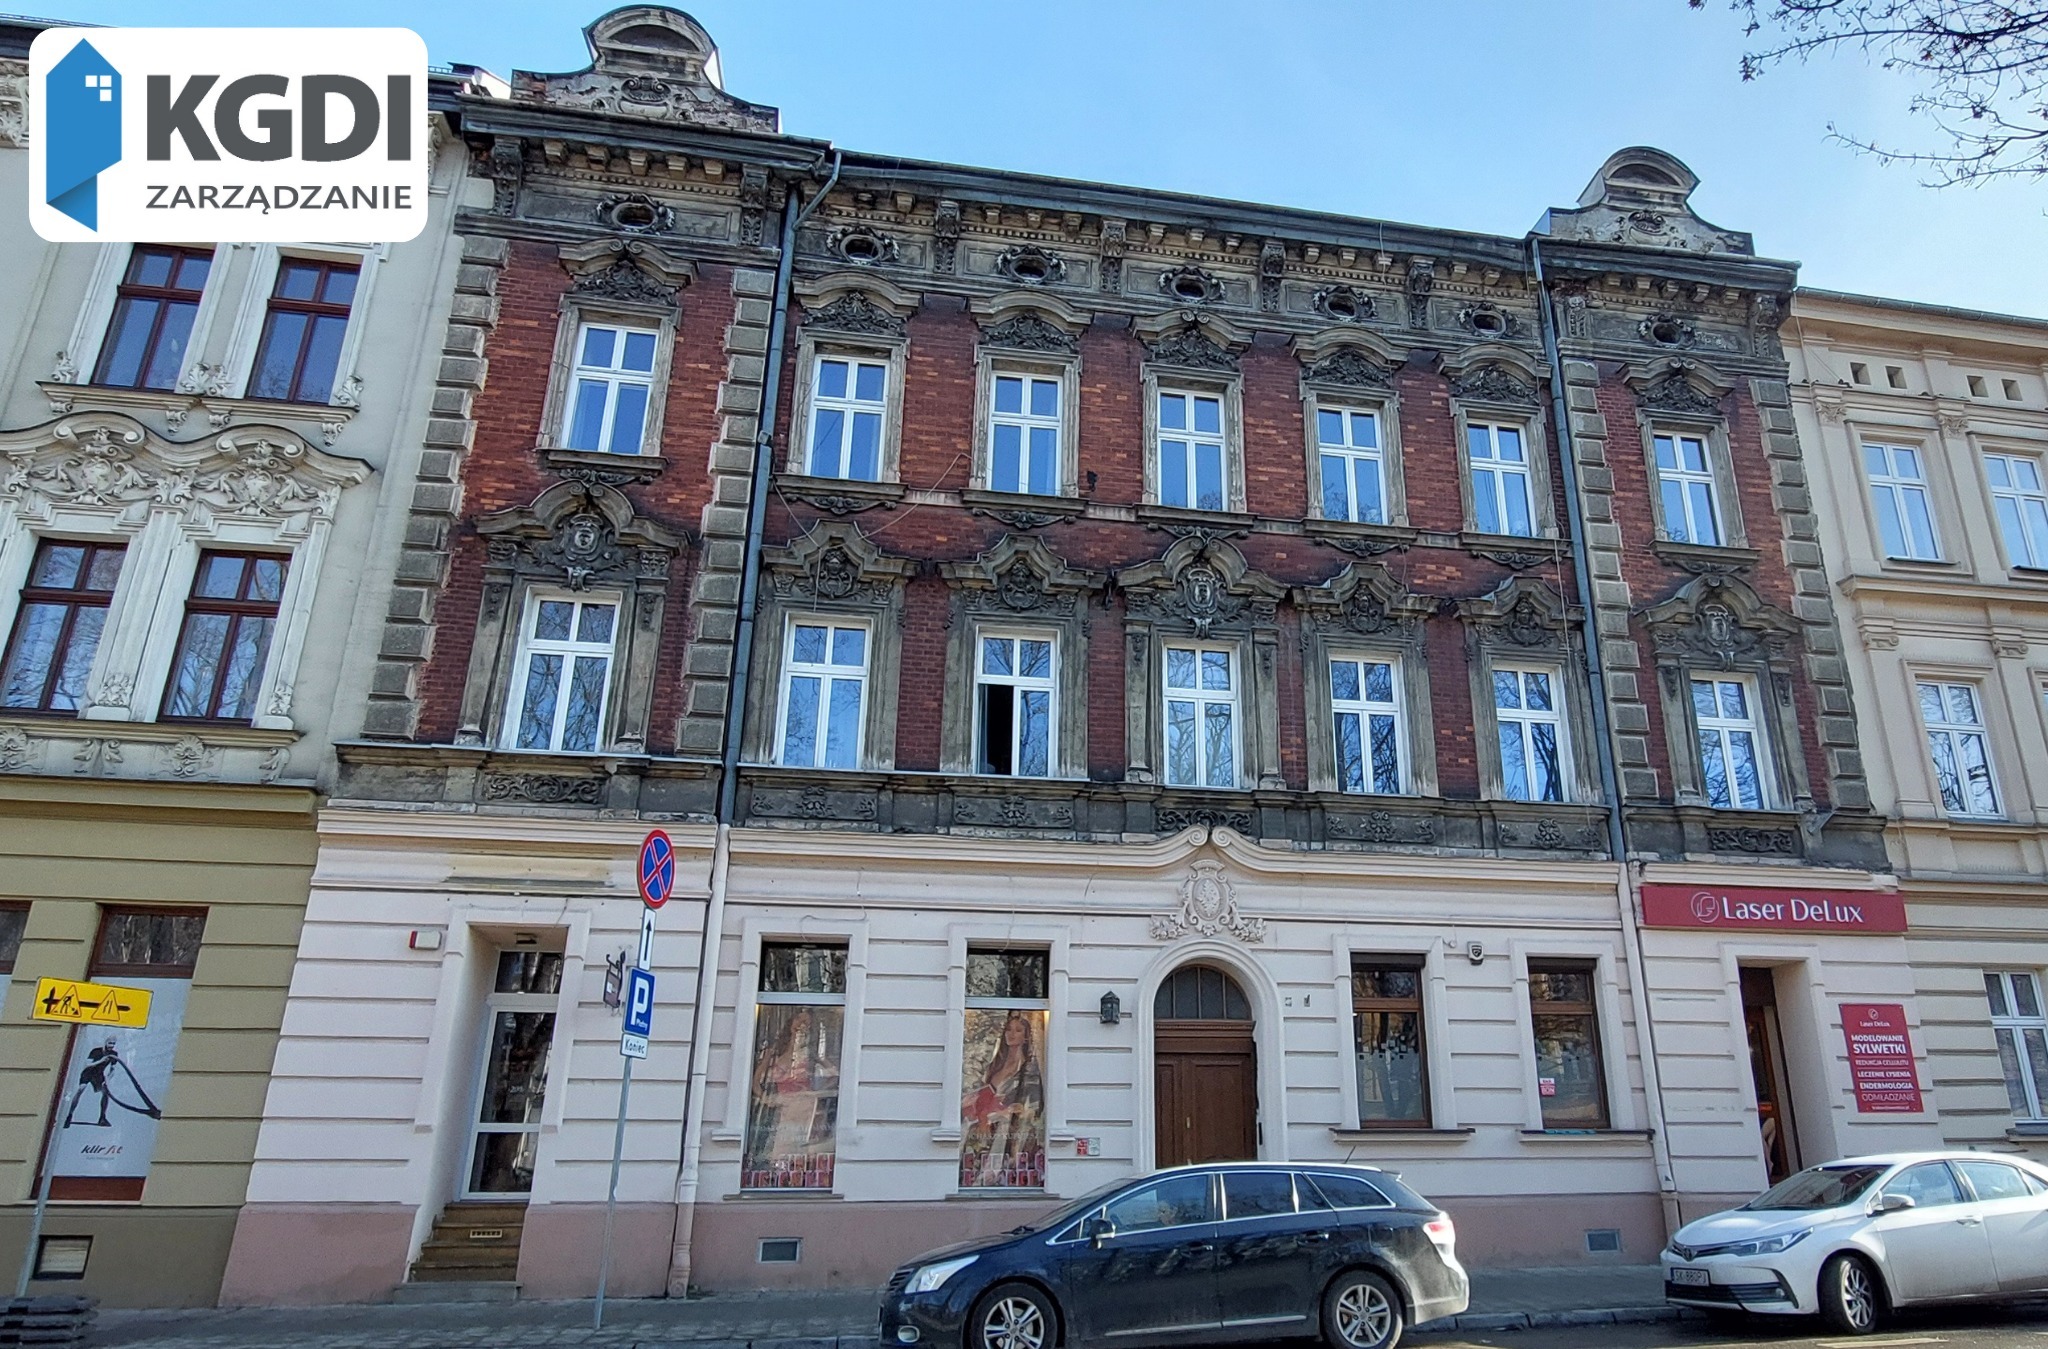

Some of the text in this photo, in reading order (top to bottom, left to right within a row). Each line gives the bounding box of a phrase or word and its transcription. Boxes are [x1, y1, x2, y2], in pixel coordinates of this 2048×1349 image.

[1722, 896, 1864, 923] Laser DeLux
[631, 977, 649, 1025] P
[624, 1039, 645, 1054] Koniec
[1853, 1043, 1906, 1054] SYLWETKI
[1859, 1082, 1914, 1090] ENDERMOLOGIA
[1862, 1093, 1915, 1101] ODMŁADZANIE
